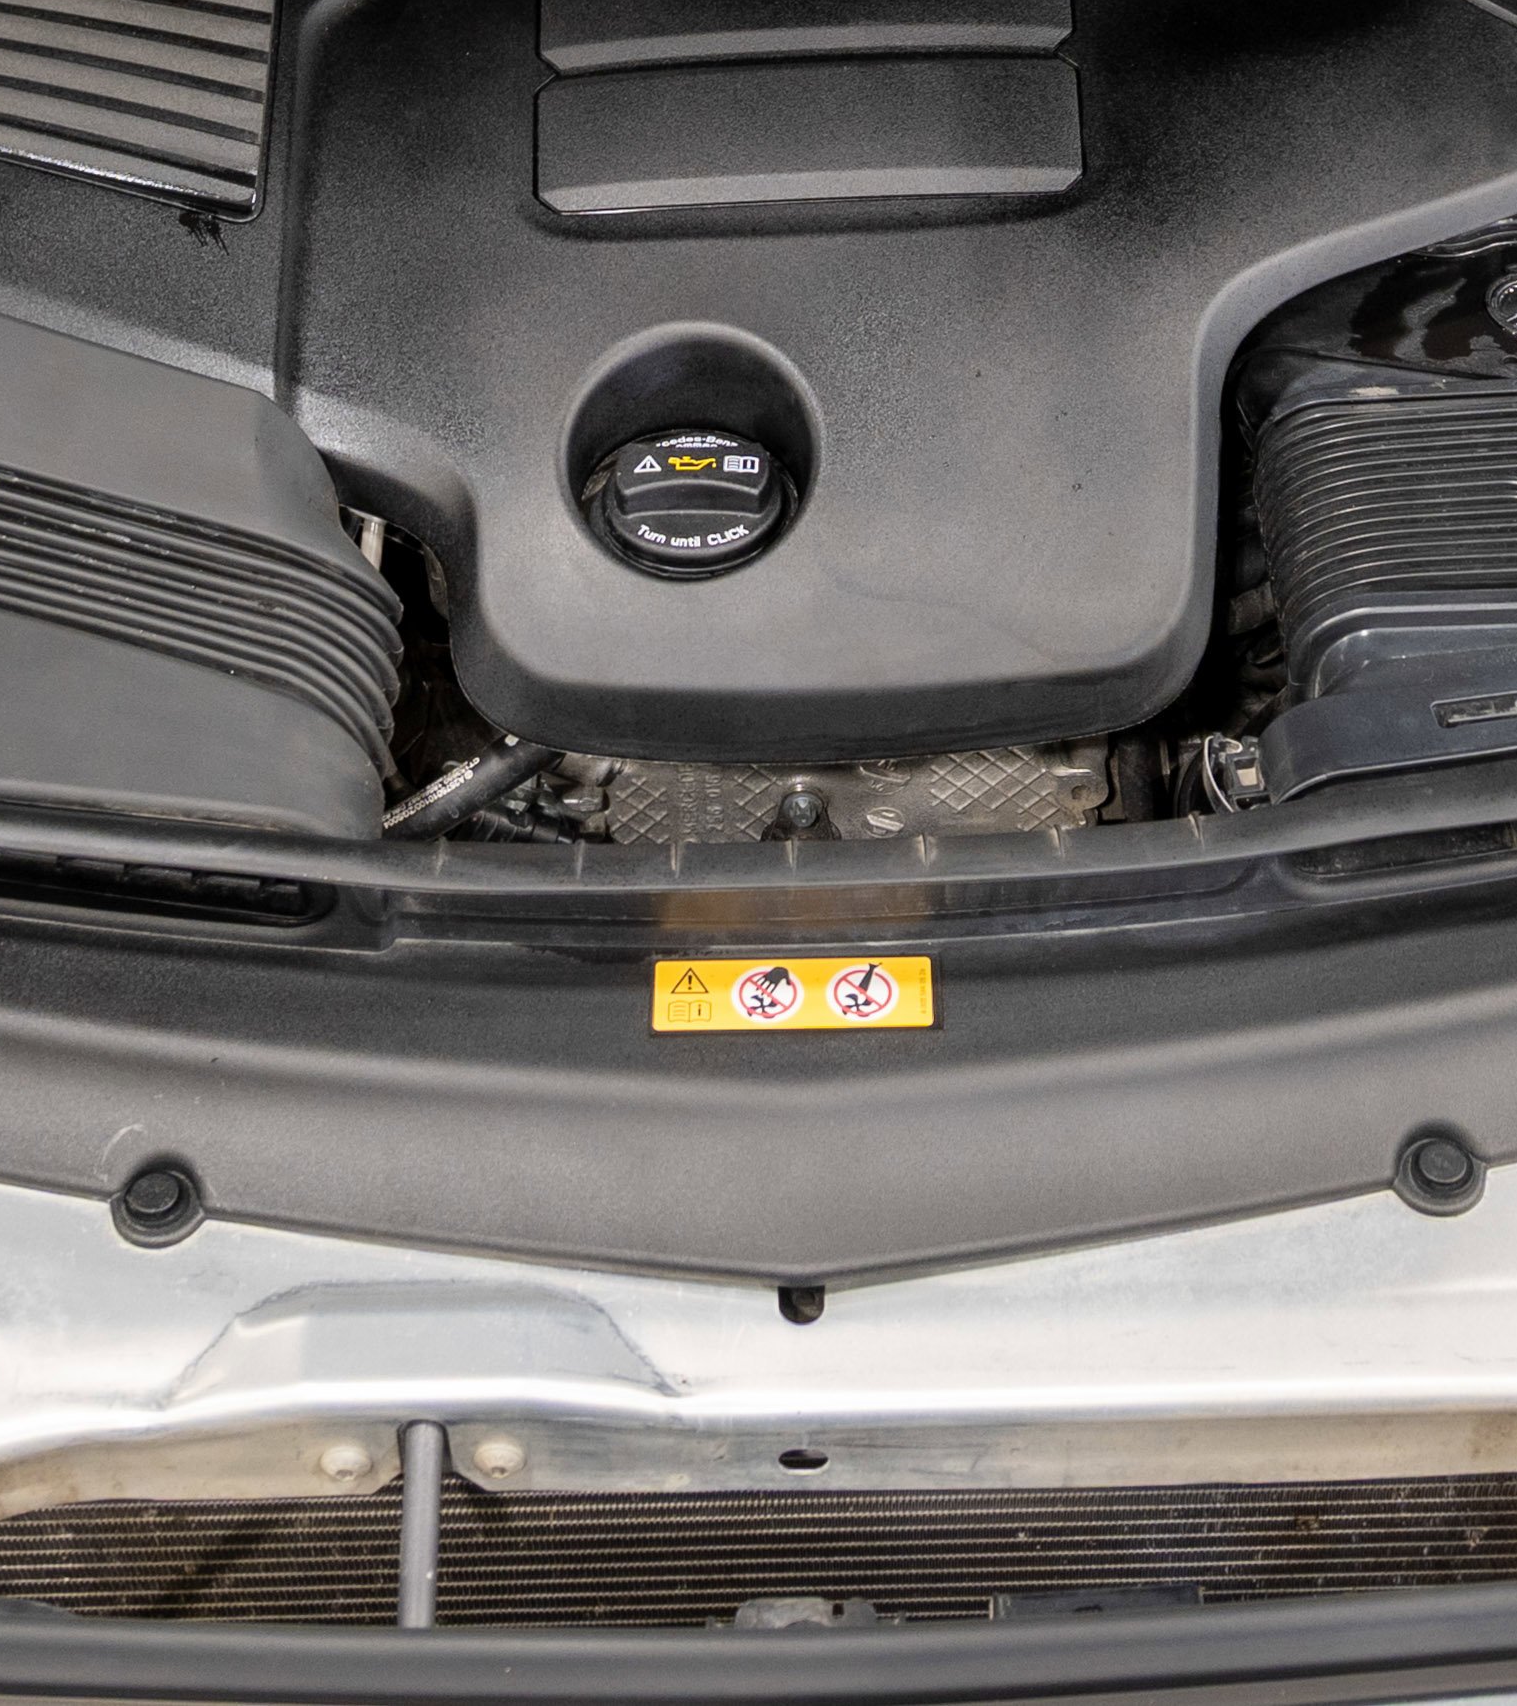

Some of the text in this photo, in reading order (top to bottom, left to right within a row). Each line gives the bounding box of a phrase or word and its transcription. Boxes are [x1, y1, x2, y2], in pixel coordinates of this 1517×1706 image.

[636, 524, 750, 548] Turn until CLICK
